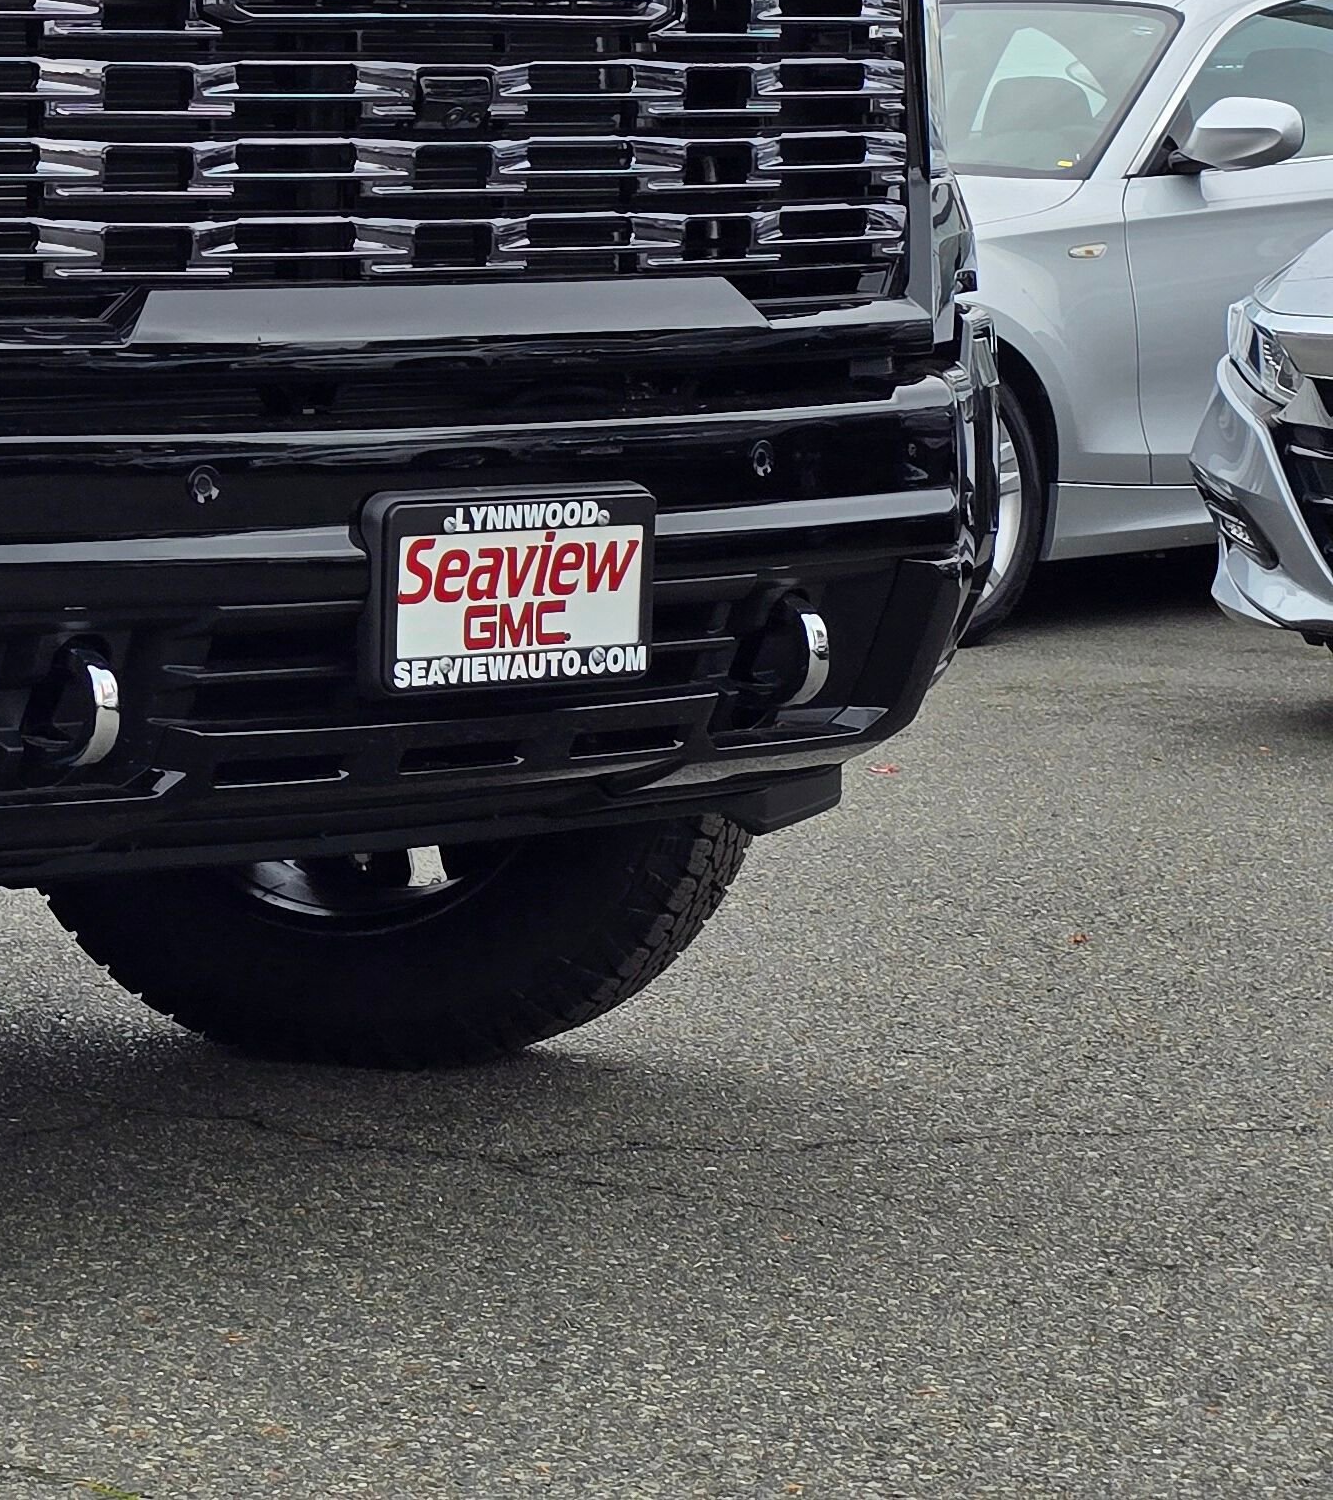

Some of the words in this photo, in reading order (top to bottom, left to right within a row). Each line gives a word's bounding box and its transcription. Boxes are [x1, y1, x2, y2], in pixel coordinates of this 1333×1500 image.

[455, 501, 599, 531] LYNNWOOD
[396, 531, 639, 604] Seaview
[463, 601, 569, 650] GMC
[393, 646, 647, 688] SEAVIEWAUTO.COM
